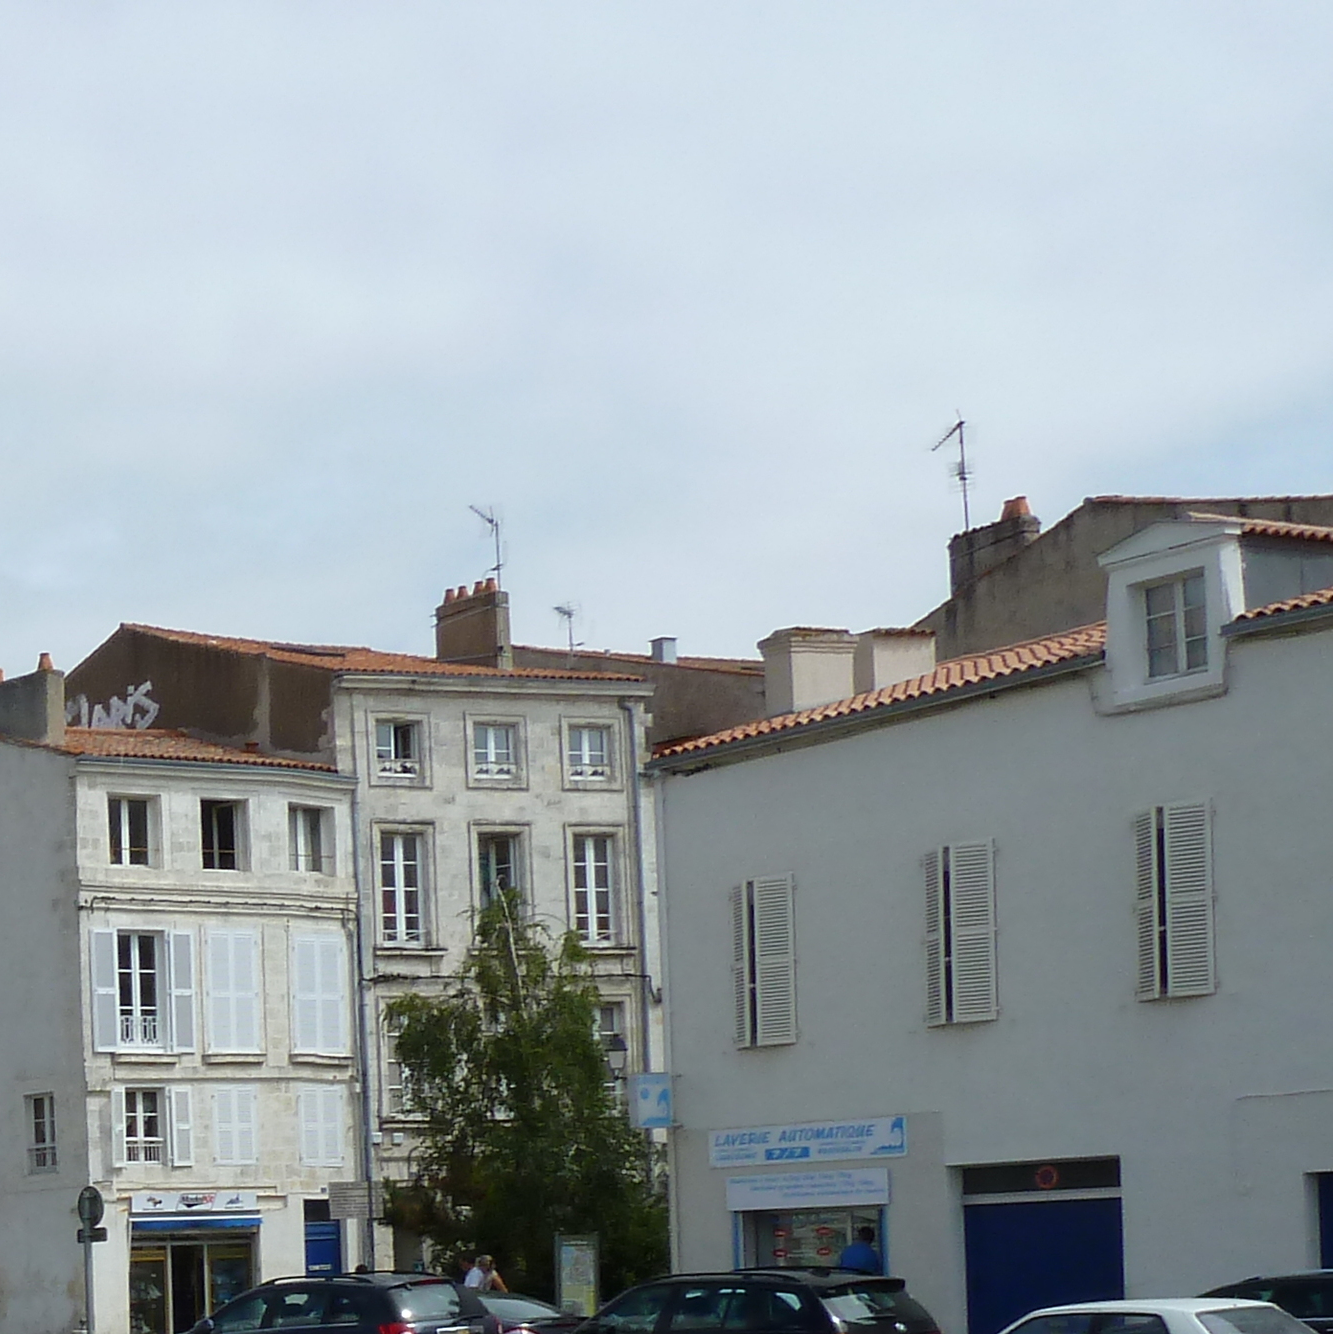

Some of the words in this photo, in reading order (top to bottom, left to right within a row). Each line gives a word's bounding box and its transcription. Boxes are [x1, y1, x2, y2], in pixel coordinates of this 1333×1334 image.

[714, 1131, 771, 1147] LAVERIE
[778, 1124, 876, 1143] AUTOMATIQUE
[770, 1147, 806, 1159] 7/7
